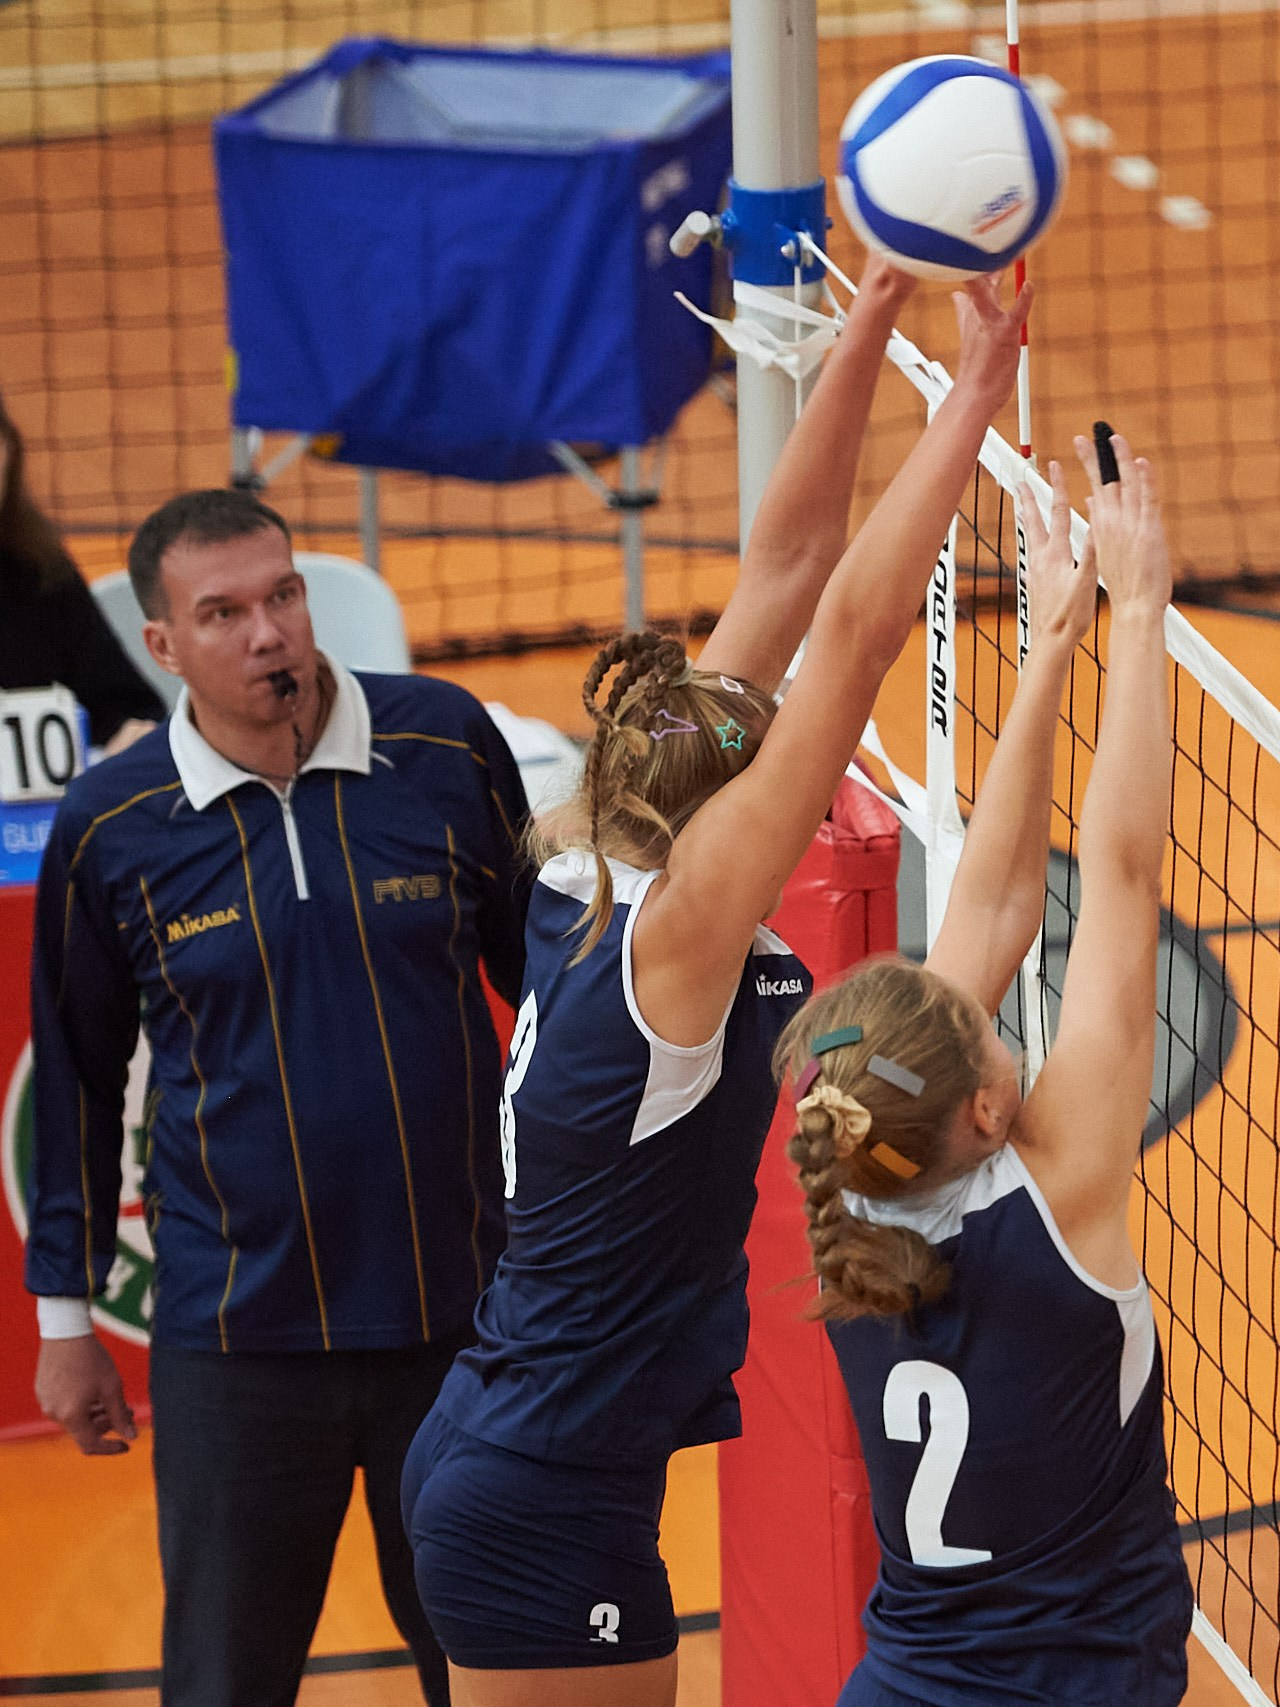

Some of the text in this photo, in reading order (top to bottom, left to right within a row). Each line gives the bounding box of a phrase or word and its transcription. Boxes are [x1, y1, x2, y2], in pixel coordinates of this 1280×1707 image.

[4, 713, 75, 786] 10
[882, 1360, 993, 1567] 2
[589, 1602, 619, 1643] 3
